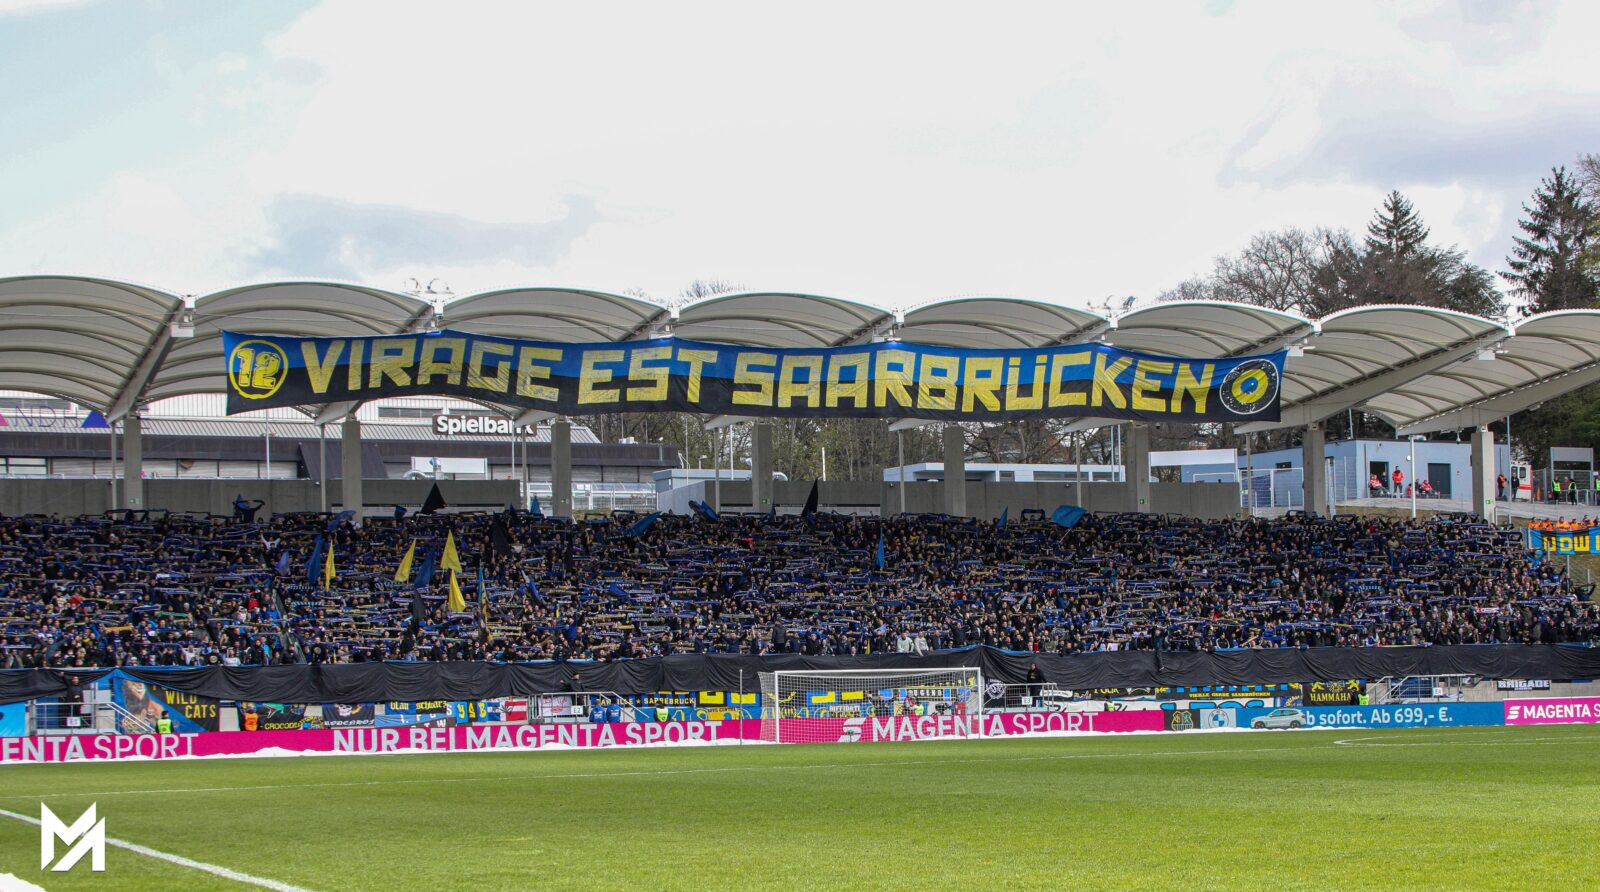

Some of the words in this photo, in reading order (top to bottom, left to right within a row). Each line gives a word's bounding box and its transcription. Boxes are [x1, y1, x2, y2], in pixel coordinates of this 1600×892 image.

[237, 348, 281, 390] 12
[301, 338, 563, 402] VIRAGE
[578, 346, 719, 404] EST
[732, 349, 1216, 414] SAARBRÜCKEN
[1497, 680, 1550, 689] BRIGADE
[166, 690, 197, 704] WILD
[185, 705, 217, 718] CATS
[1319, 710, 1366, 724] sofort.
[1370, 709, 1390, 723] Ab
[1395, 708, 1434, 725] 699,-
[1439, 707, 1453, 722] €.
[1523, 704, 1591, 719] MAGENTA
[333, 728, 399, 753] NUR
[410, 727, 455, 751] BEI
[466, 722, 614, 750] MAGENTA
[625, 721, 722, 748] SPORT
[872, 715, 1006, 741] MAGENTA
[1012, 713, 1099, 735] SPORT
[2, 736, 86, 762] ENTA
[94, 733, 199, 761] SPORT
